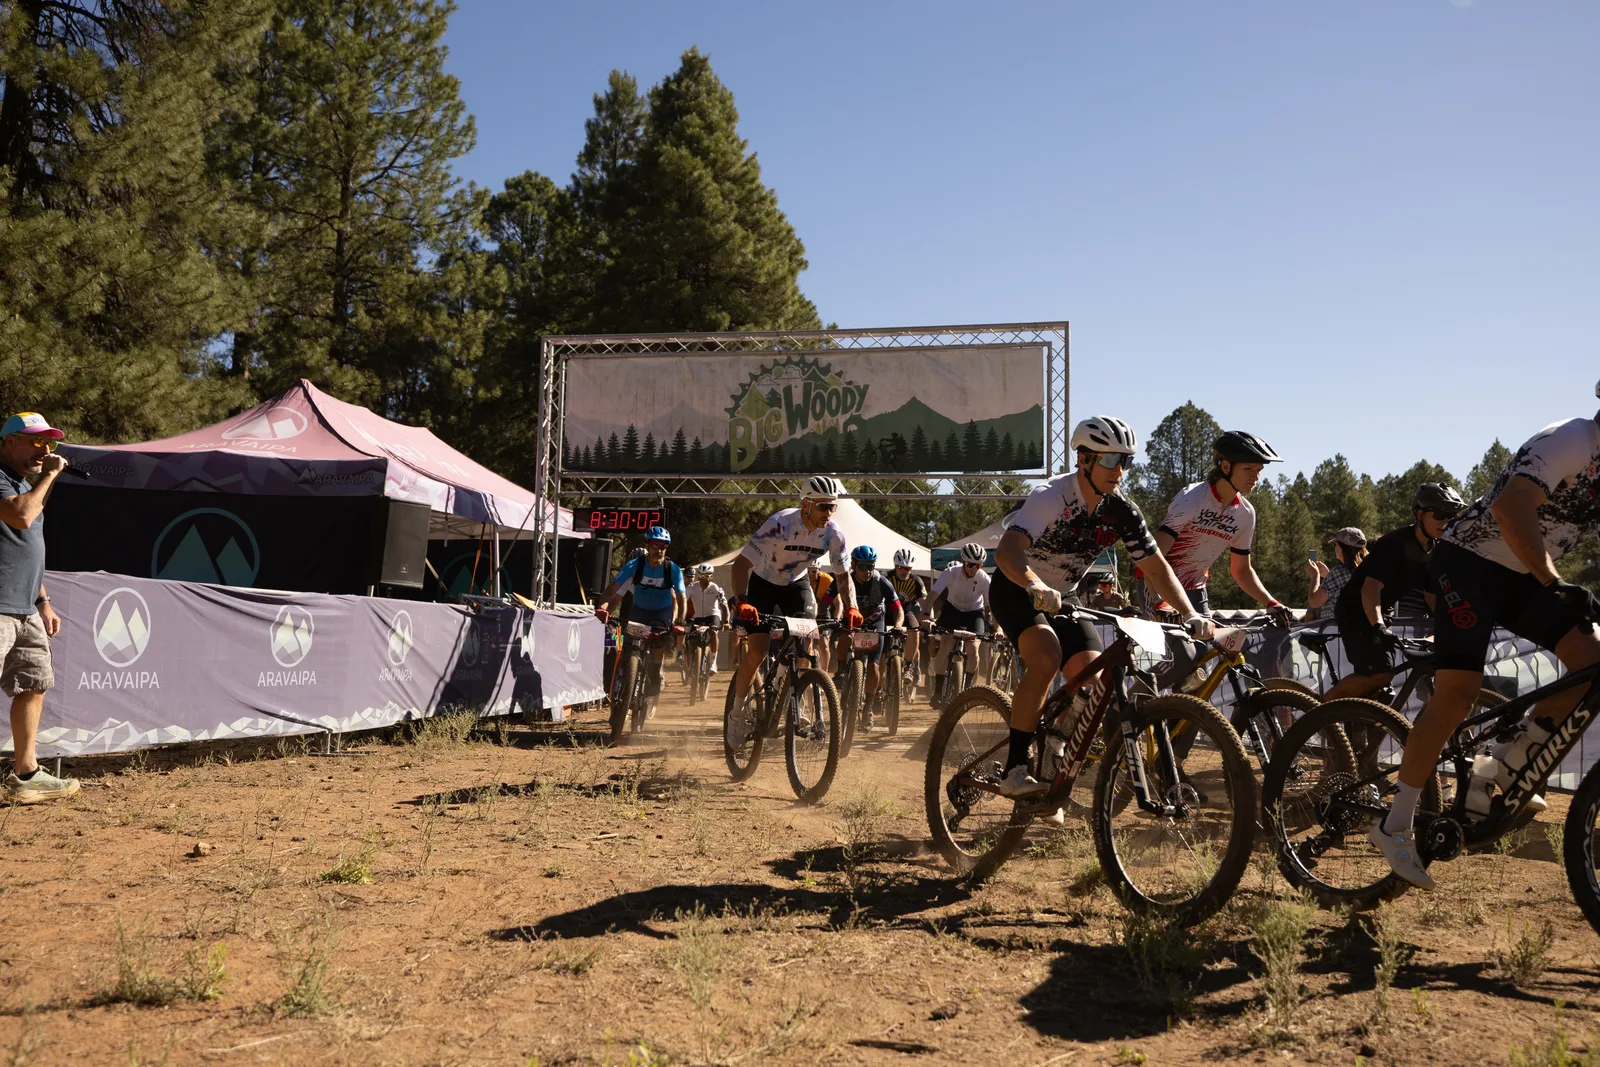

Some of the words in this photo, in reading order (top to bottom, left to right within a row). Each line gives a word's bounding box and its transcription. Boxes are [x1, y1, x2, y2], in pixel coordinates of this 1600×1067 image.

[728, 407, 783, 472] BIG
[782, 381, 870, 436] WOODY
[178, 440, 297, 453] ARAVAIPA
[314, 472, 375, 485] ARAVAIPA
[1200, 508, 1235, 525] Youth
[796, 623, 811, 631] 133
[1224, 636, 1236, 650] 119
[78, 671, 160, 690] ARAVAIPA
[257, 670, 317, 687] ARAVAIPA
[1060, 680, 1107, 779] SPECIALIZED
[1504, 701, 1591, 815] S-WORKS
